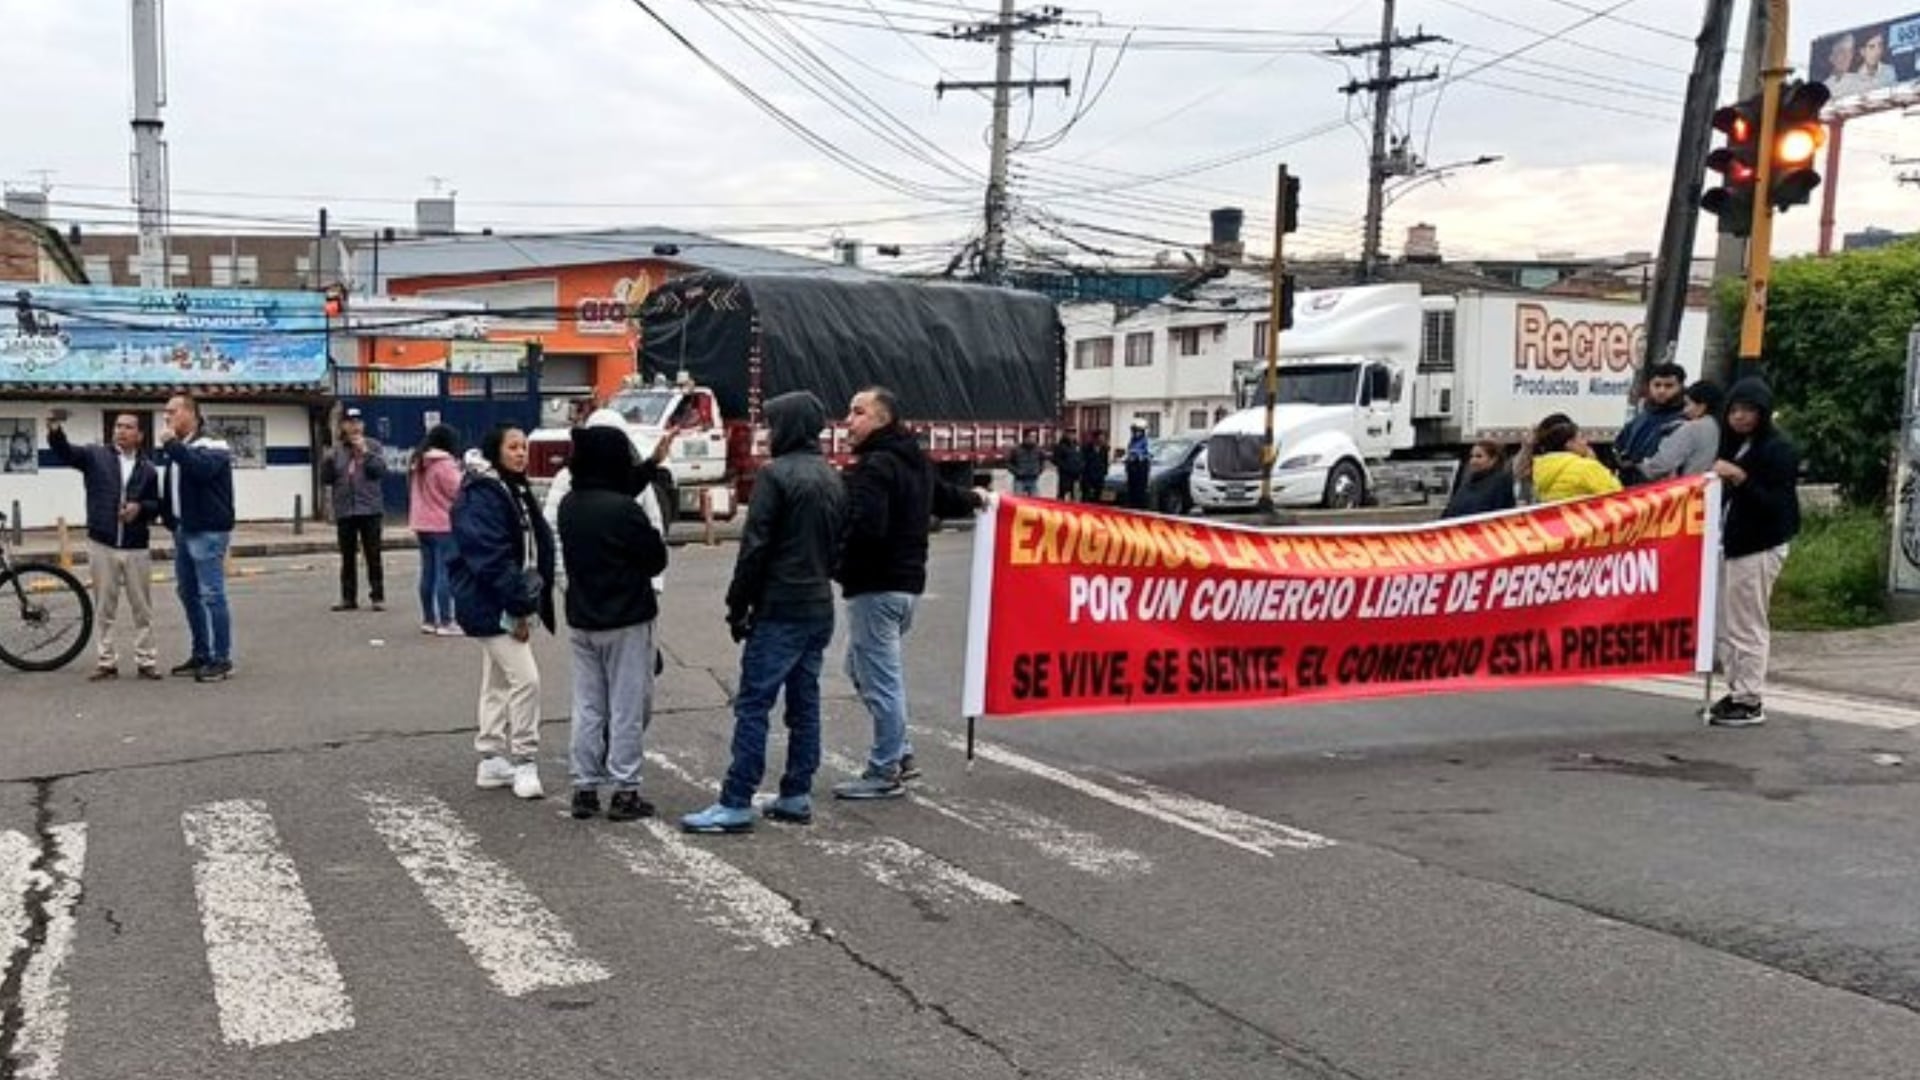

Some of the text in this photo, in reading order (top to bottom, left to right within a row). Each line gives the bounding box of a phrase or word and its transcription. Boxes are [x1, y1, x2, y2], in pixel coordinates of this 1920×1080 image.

[582, 300, 627, 323] ara
[1513, 374, 1579, 395] Productos
[1010, 484, 1705, 571] EXIGIMOS LA PRESENCIA DEL ALCALDE
[1070, 550, 1659, 622] POR UN COMERCIO LIBRE DE PERSECUCION
[1012, 618, 1696, 703] SE VIVE, SE SIENTE, EL COMERCIO ESTA PRESENTE
